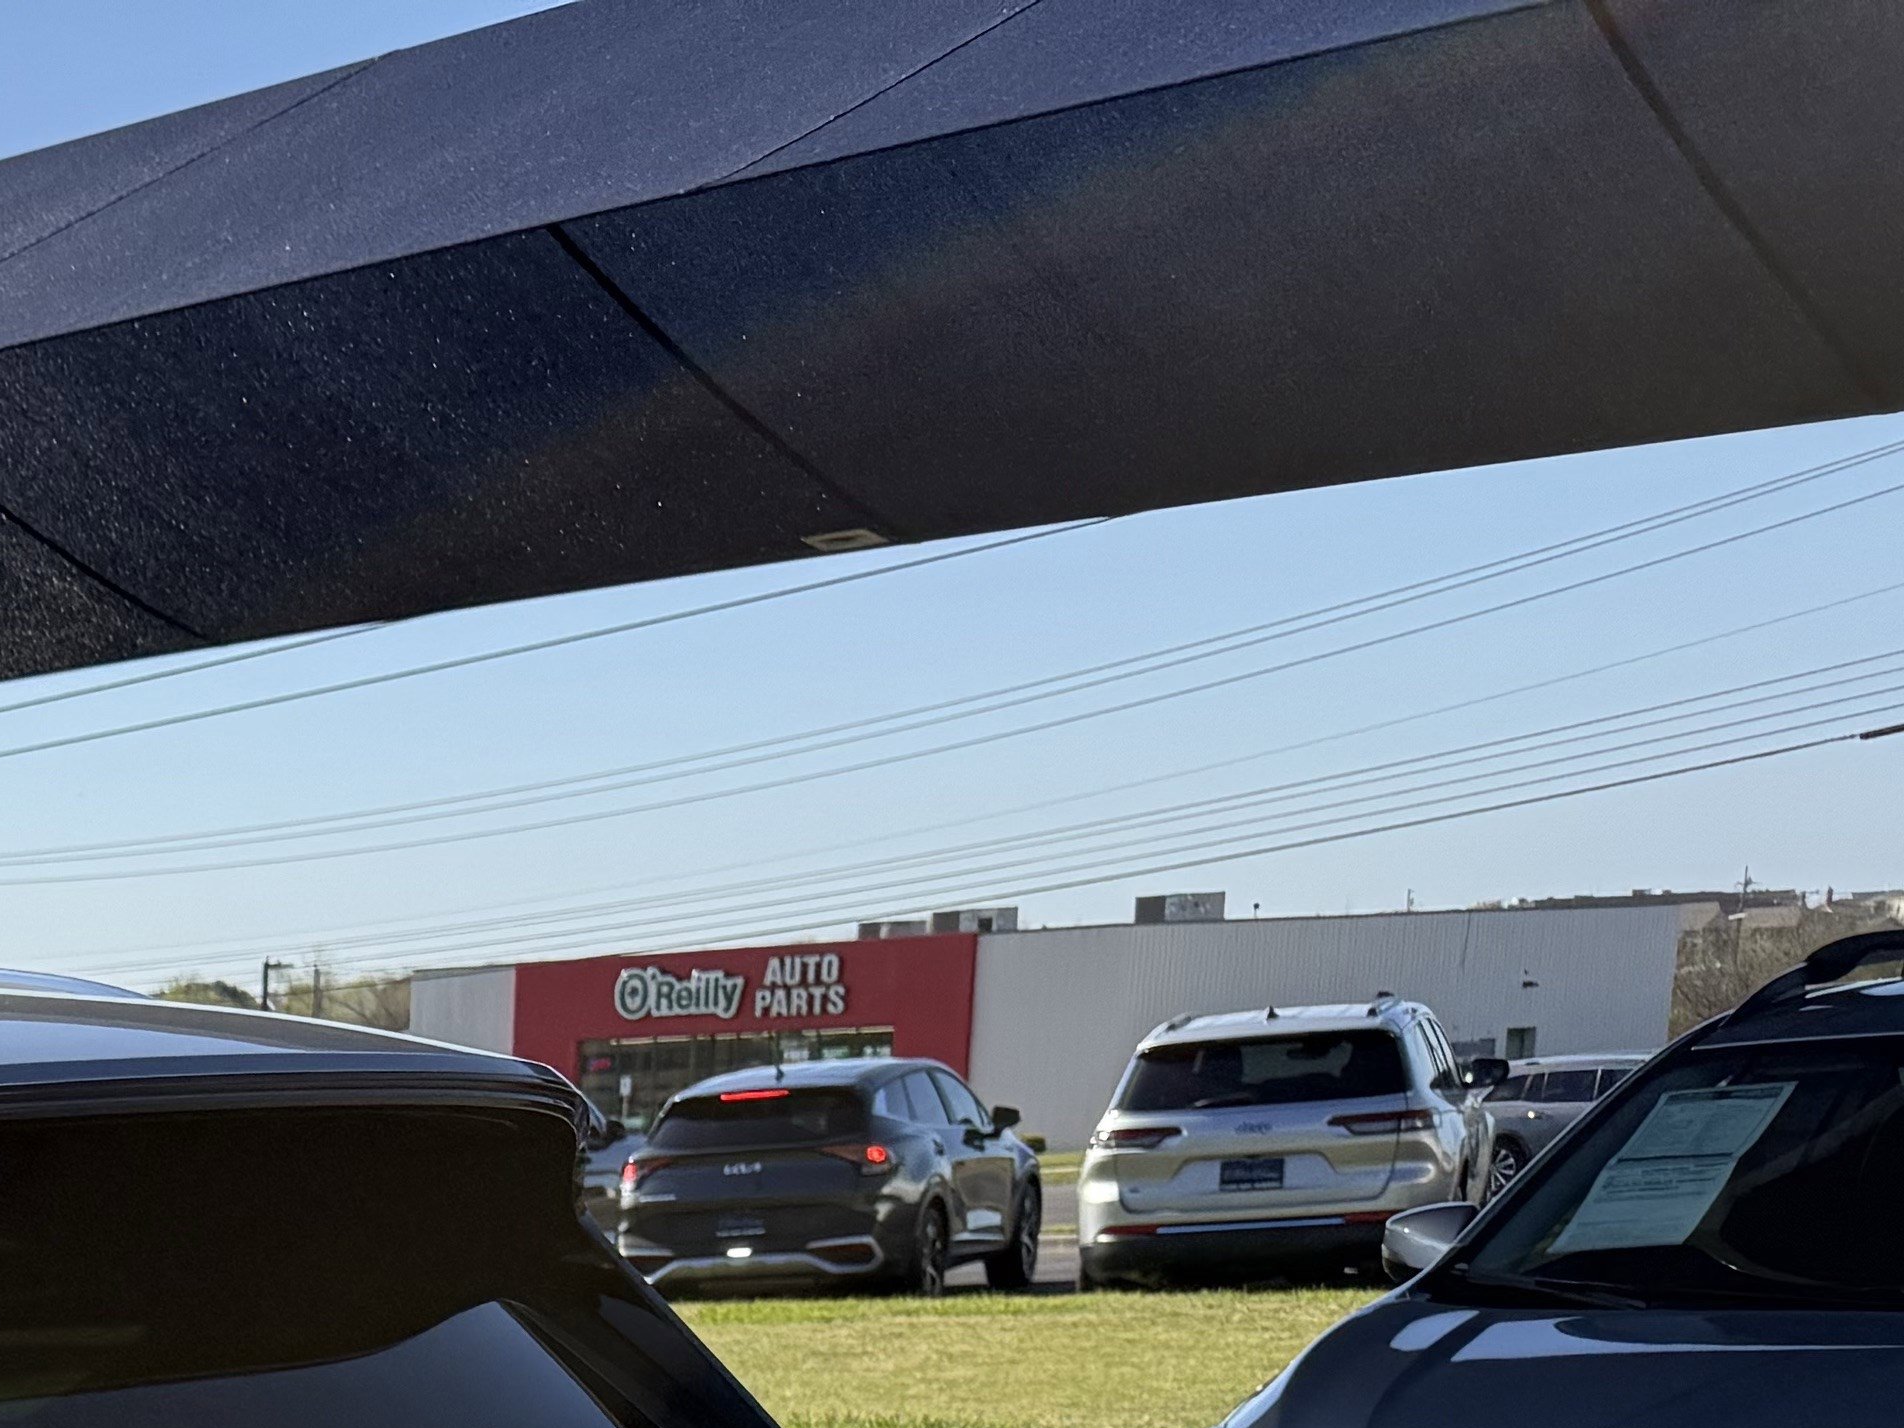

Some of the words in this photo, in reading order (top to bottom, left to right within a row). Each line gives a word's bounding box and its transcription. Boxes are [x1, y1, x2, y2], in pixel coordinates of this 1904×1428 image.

[764, 953, 840, 986] AUTO
[616, 967, 744, 1019] O'Reilly
[754, 985, 845, 1018] PARTS
